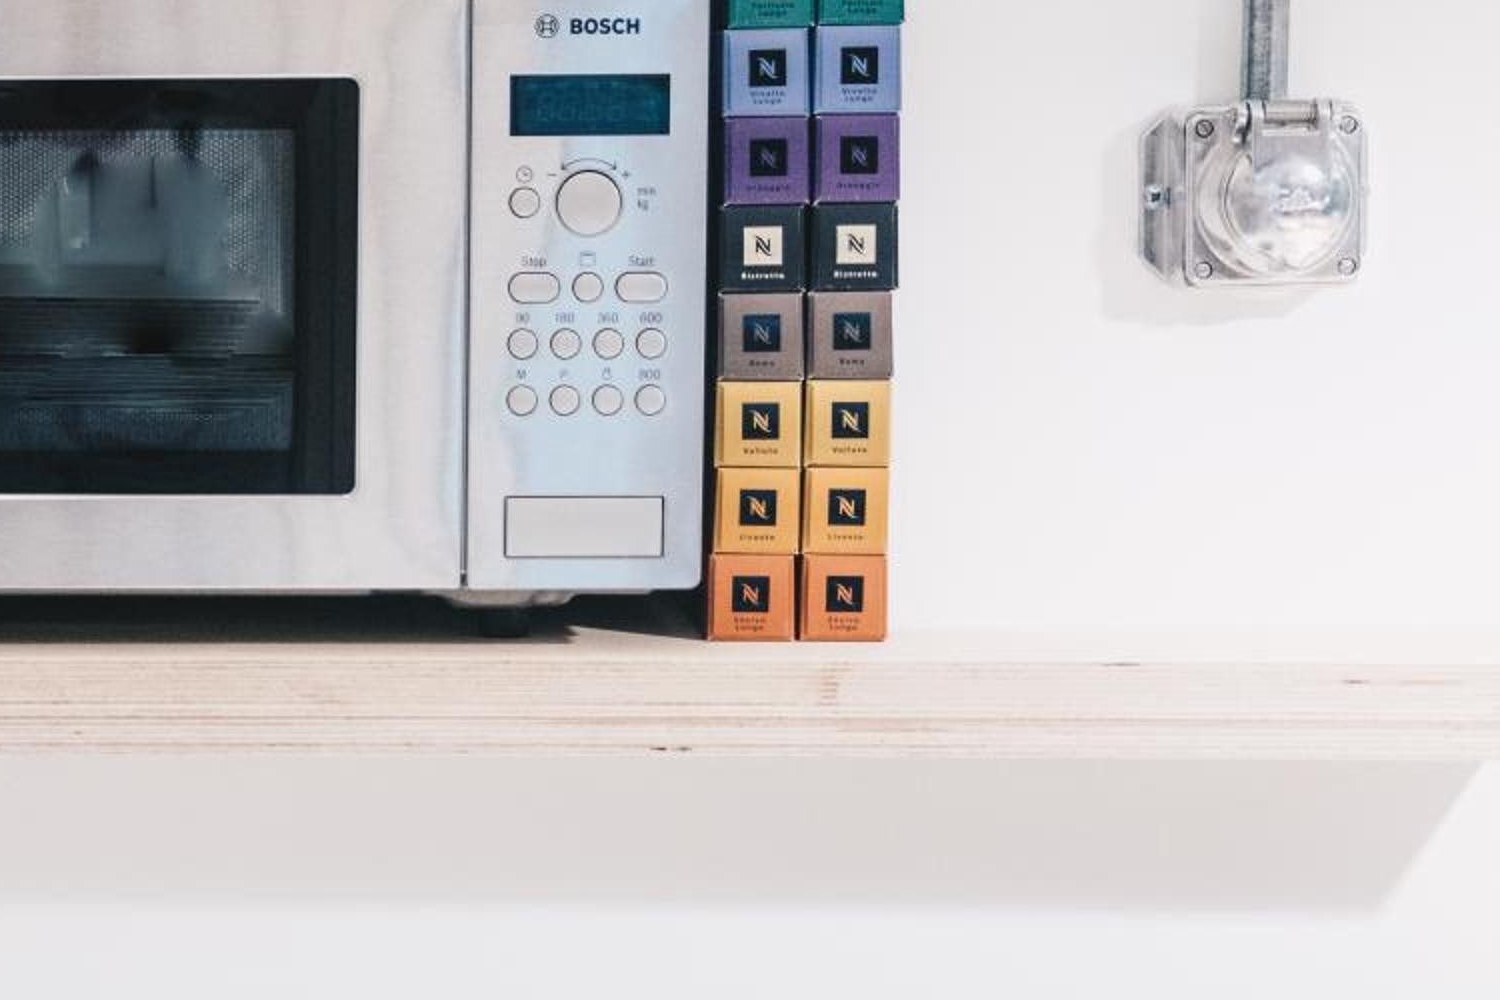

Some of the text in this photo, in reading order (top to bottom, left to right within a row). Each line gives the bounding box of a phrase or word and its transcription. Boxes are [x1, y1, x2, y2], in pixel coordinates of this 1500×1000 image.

[570, 17, 641, 35] BOSCH
[521, 255, 548, 268] Stop
[628, 255, 655, 267] Start
[555, 313, 575, 324] 180
[598, 313, 619, 324] 360
